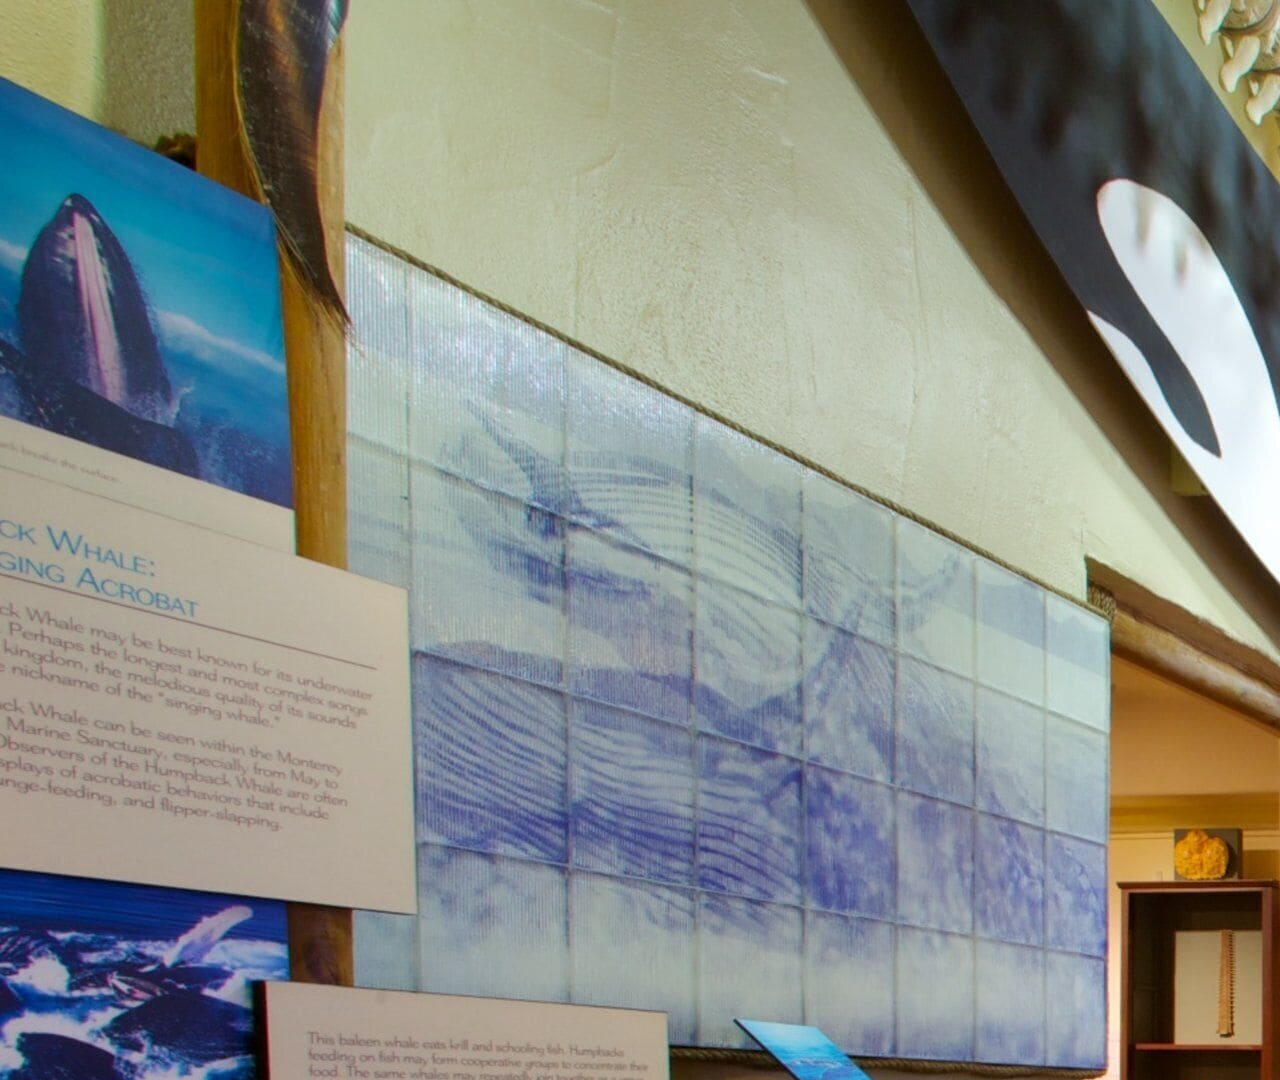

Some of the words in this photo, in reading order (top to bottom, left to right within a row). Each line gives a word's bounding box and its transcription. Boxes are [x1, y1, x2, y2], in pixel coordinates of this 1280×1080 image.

[46, 525, 154, 576] WHALE:
[76, 567, 197, 616] ACROBAT
[2, 638, 88, 672] kingdom,
[93, 659, 122, 678] the
[127, 670, 210, 697] melodious
[213, 691, 264, 712] quality
[267, 699, 283, 717] of
[286, 702, 303, 718] its
[306, 710, 357, 729] sounds
[8, 621, 84, 652] Perhaps
[89, 640, 118, 661] the
[122, 647, 182, 674] longest
[186, 667, 218, 682] and
[221, 675, 260, 692] most
[263, 685, 324, 705] complex
[25, 606, 84, 633] Whale
[89, 627, 127, 647] may
[130, 631, 153, 650] be
[157, 637, 192, 660] best
[196, 646, 248, 672] known
[251, 660, 271, 677] for
[275, 668, 293, 683] its
[296, 676, 372, 700] underwater
[10, 664, 100, 692] nickname
[104, 681, 122, 696] of
[125, 685, 152, 703] the
[157, 691, 222, 721] "singing
[225, 708, 281, 728] whale."
[5, 715, 71, 741] Marine
[76, 728, 167, 760] Sanctuary,
[172, 752, 248, 776] especially
[252, 761, 286, 779] from
[289, 768, 320, 789] May
[323, 777, 339, 791] to
[29, 701, 88, 726] Whale
[92, 719, 125, 733] can
[129, 720, 152, 738] be
[156, 731, 195, 746] seen
[198, 738, 245, 755] within
[248, 744, 273, 761] the
[276, 749, 342, 776] Monterey
